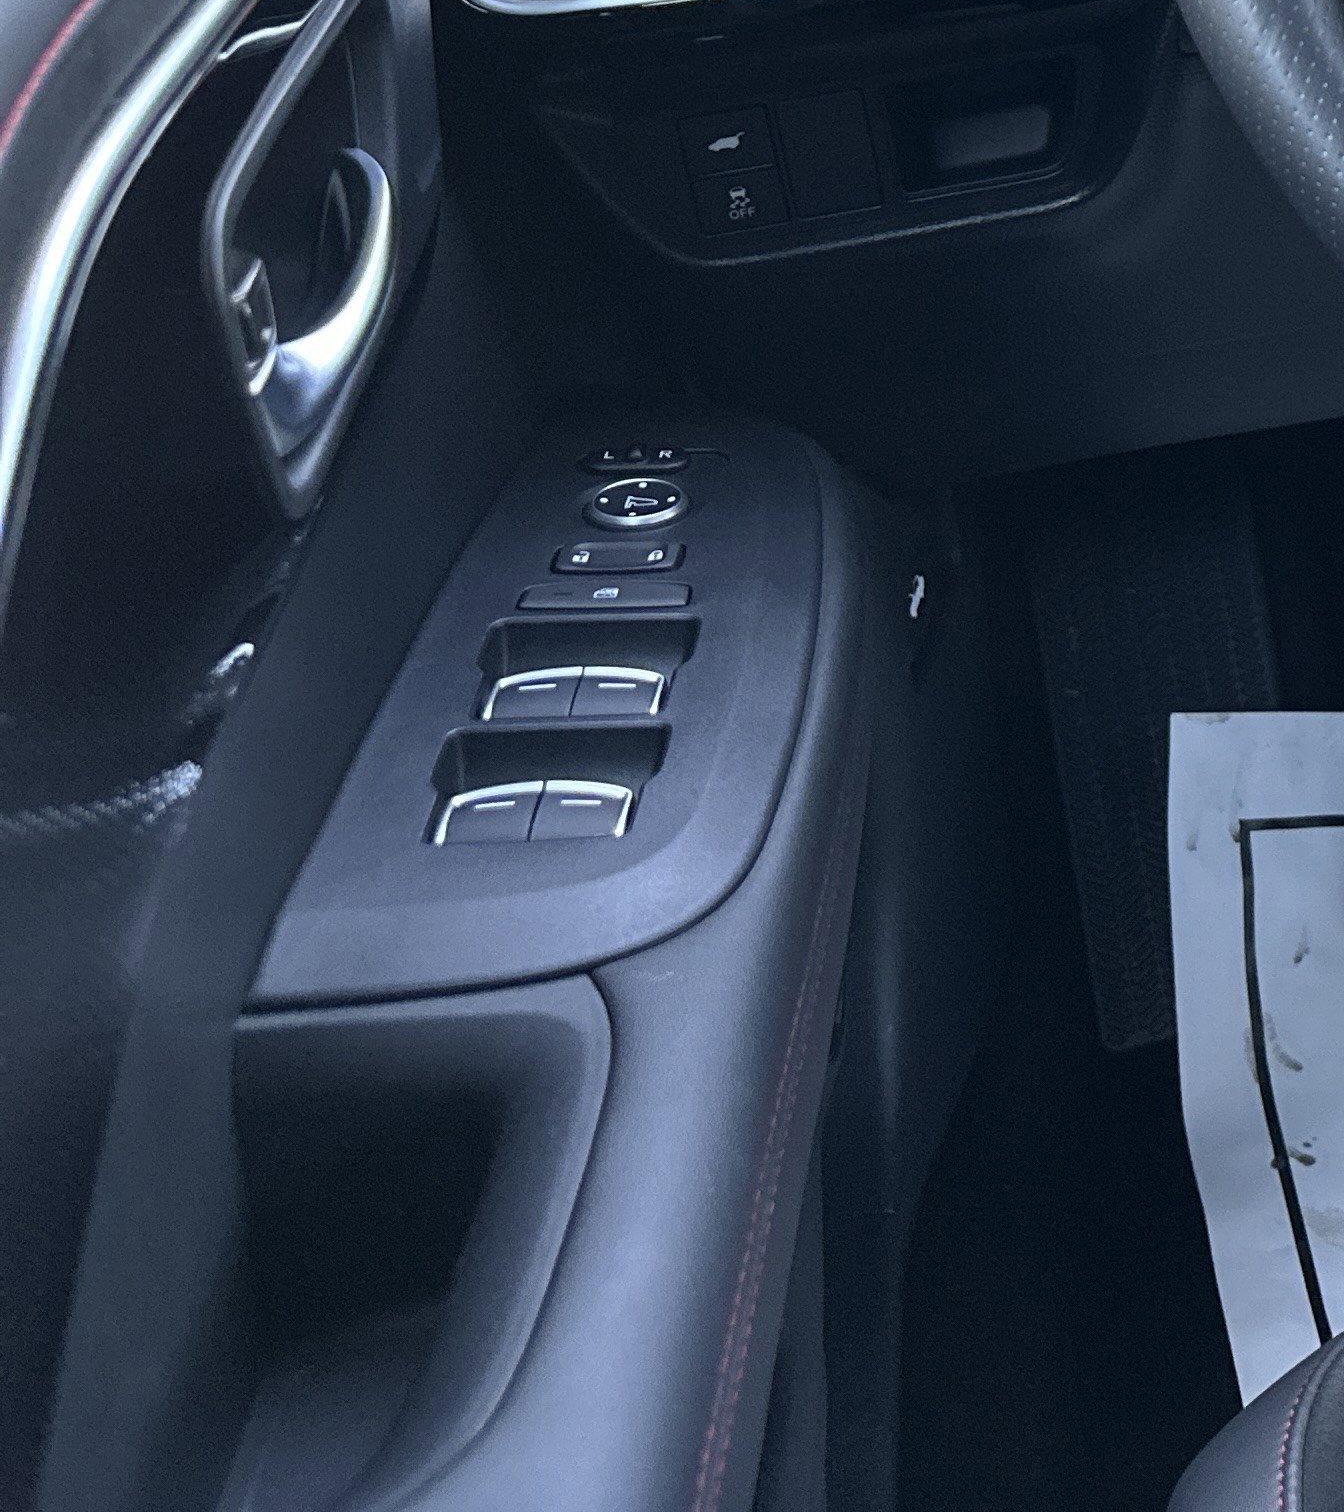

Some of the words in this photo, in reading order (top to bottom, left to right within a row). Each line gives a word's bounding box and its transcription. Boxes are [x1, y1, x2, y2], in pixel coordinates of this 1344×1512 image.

[729, 206, 756, 220] OFF
[604, 450, 615, 459] L
[659, 449, 673, 459] R
